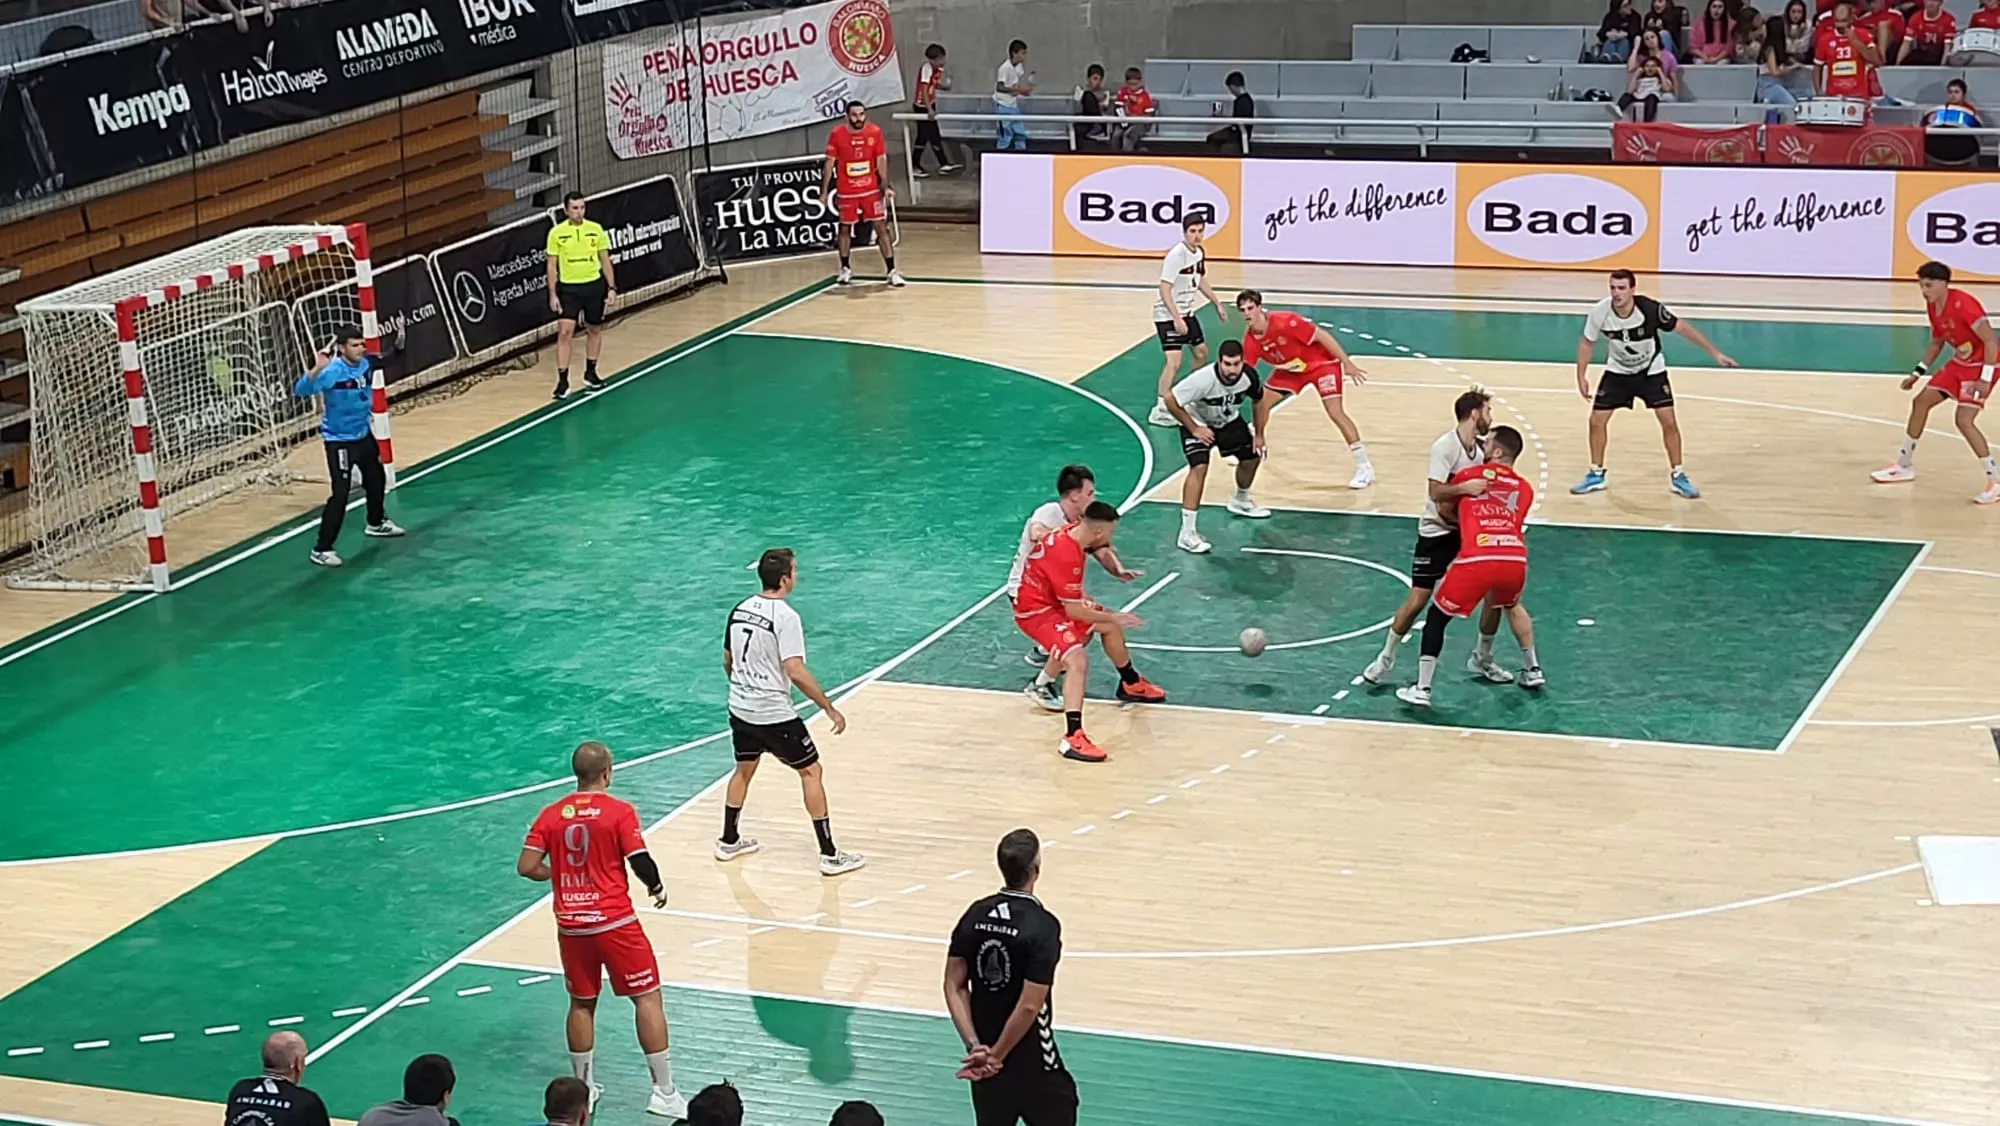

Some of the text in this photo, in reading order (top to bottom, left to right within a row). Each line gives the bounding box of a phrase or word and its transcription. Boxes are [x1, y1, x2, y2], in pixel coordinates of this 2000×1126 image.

[336, 8, 439, 60] ALAMEDA
[701, 22, 818, 66] ORGULLO
[1836, 46, 1852, 59] 33
[342, 39, 445, 78] CENTRO DEPORTIVO
[666, 78, 692, 104] DE
[704, 60, 798, 97] HUESCA
[88, 83, 191, 136] Kempa
[1079, 192, 1216, 225] Bada
[1264, 183, 1448, 240] get the difference
[1484, 202, 1634, 236] Bada
[1686, 192, 1886, 252] get the difference
[1926, 212, 2000, 246] Ba
[487, 249, 547, 280] Mercedes-Be
[742, 627, 753, 662] 7
[565, 823, 589, 867] 9
